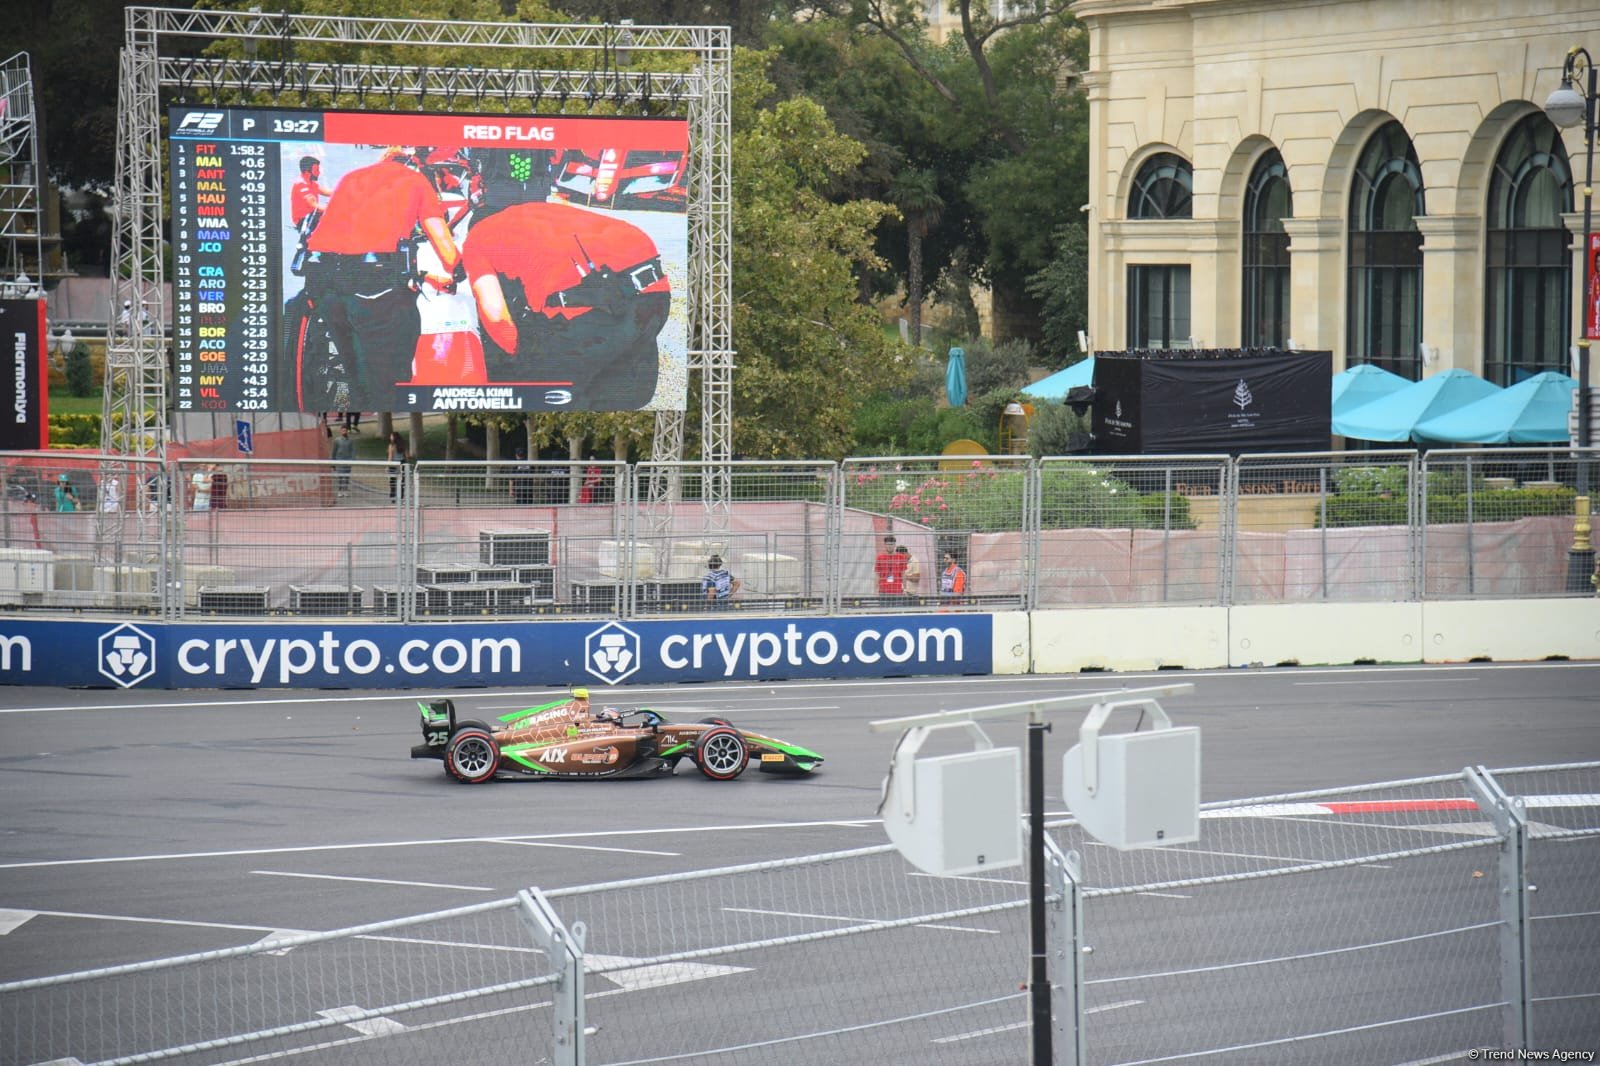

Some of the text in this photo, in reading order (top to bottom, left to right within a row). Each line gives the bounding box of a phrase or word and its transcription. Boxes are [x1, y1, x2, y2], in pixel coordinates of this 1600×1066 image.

[179, 112, 224, 128] F2
[242, 118, 255, 131] P
[273, 119, 319, 133] 19:27
[463, 124, 555, 141] RED FLAG
[178, 144, 265, 156] 1 FIT 1:58.2
[178, 156, 265, 168] 2 MAI +0.6
[179, 169, 265, 180] 3 ANT +0.7
[179, 181, 266, 193] 4 MAL +0.9
[179, 193, 266, 205] 5 HAU +1.3
[180, 206, 266, 217] 6 MIN +1.3
[180, 218, 266, 229] 7 VMA +1.3
[180, 231, 266, 241] 8 MAN +1.5
[181, 242, 267, 253] 9 JCO +1.8
[178, 255, 267, 265] 10 +1.9
[178, 267, 267, 277] 11 CRA +2.2
[179, 279, 267, 289] 12 ARO +2.3
[179, 291, 267, 301] 13 VER +2.3
[179, 303, 267, 314] 14 BRO +2.4
[179, 316, 192, 324] 15
[242, 316, 267, 326] +2.5
[179, 327, 267, 337] 16 BOR +2.8
[179, 339, 267, 349] 17 ACO +2.9
[179, 352, 267, 361] 18 GOE +2.9
[179, 364, 192, 373] 19
[243, 363, 268, 373] +4.0
[14, 332, 27, 423] Filarmoniya
[179, 376, 267, 385] 20 MIY +4.3
[179, 388, 268, 398] 21 VIL +5.4
[433, 388, 513, 398] ANDREA KIMI
[179, 401, 192, 409] 22
[235, 400, 268, 409] +10.4
[407, 394, 417, 404] 3
[433, 398, 522, 410] ANTONELLI
[1284, 480, 1322, 495] HOTE
[660, 623, 963, 677] crypto.com
[177, 631, 521, 684] crypto.com
[428, 731, 449, 746] 25
